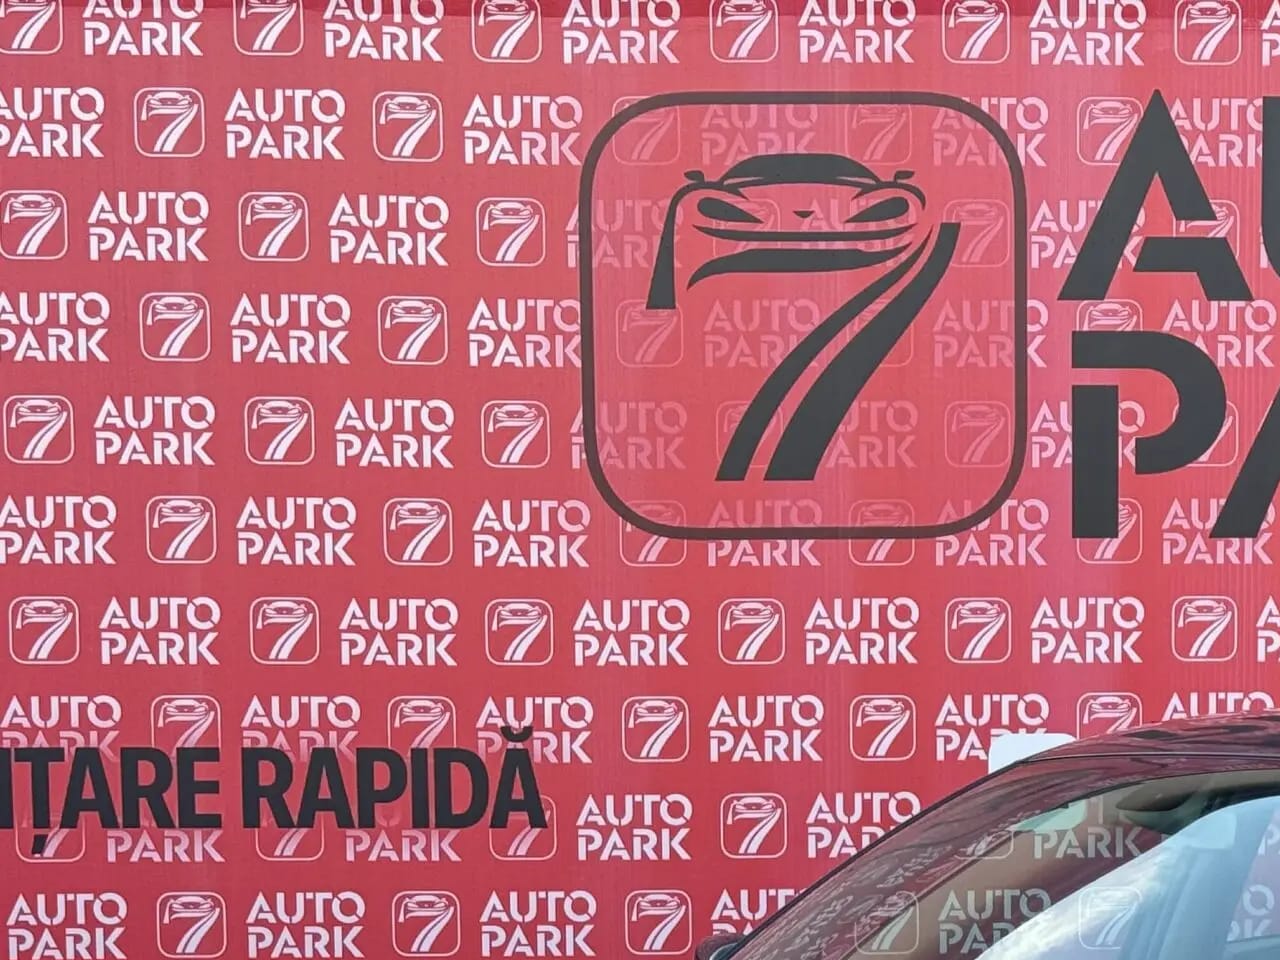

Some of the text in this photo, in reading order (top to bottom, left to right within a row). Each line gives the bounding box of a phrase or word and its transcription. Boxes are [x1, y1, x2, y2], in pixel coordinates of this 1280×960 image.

[561, 0, 681, 28] AUTO
[797, 0, 916, 27] AUTO
[1028, 0, 1147, 30] AUTO
[84, 20, 204, 56] PARK
[324, 25, 444, 62] PARK
[562, 29, 680, 65] PARK
[799, 28, 914, 64] PARK
[1030, 31, 1145, 66] PARK
[224, 87, 346, 124] AUTO
[462, 94, 583, 130] AUTO
[226, 124, 345, 161] PARK
[464, 129, 582, 166] PARK
[87, 191, 209, 226] AUTO
[327, 193, 450, 230] AUTO
[89, 226, 209, 262] PARK
[330, 229, 449, 266] PARK
[229, 293, 351, 329] AUTO
[1162, 299, 1277, 332] AUTO
[231, 328, 350, 365] PARK
[93, 395, 216, 430] AUTO
[334, 397, 455, 433] AUTO
[95, 431, 215, 466] PARK
[336, 433, 454, 469] PARK
[0, 495, 117, 529] AUTO
[236, 496, 357, 531] AUTO
[471, 499, 591, 533] AUTO
[0, 530, 116, 565] PARK
[237, 531, 356, 566] PARK
[473, 534, 589, 568] PARK
[935, 533, 1046, 566] PARK
[1163, 532, 1273, 565] PARK
[99, 596, 221, 630] AUTO
[338, 598, 459, 632] AUTO
[572, 598, 690, 632] AUTO
[804, 597, 920, 630] AUTO
[1030, 596, 1145, 630] AUTO
[101, 631, 220, 665] PARK
[341, 632, 458, 666] PARK
[574, 633, 689, 667] PARK
[805, 631, 918, 665] PARK
[1031, 631, 1143, 664] PARK
[0, 695, 122, 728] AUTO
[241, 695, 361, 728] AUTO
[476, 696, 594, 729] AUTO
[708, 694, 824, 728] AUTO
[935, 693, 1051, 727] AUTO
[709, 729, 823, 762] PARK
[0, 725, 548, 855] ȚARE RAPIDĂ
[575, 793, 693, 826] AUTO
[806, 791, 921, 824] AUTO
[106, 829, 226, 863] PARK
[345, 829, 462, 862] PARK
[577, 828, 691, 861] PARK
[1033, 826, 1143, 859] PARK
[6, 892, 127, 926] AUTO
[246, 891, 366, 924] AUTO
[479, 890, 597, 923] AUTO
[937, 889, 1053, 922] AUTO
[8, 927, 127, 960] PARK
[247, 925, 364, 958] PARK
[481, 924, 595, 957] PARK
